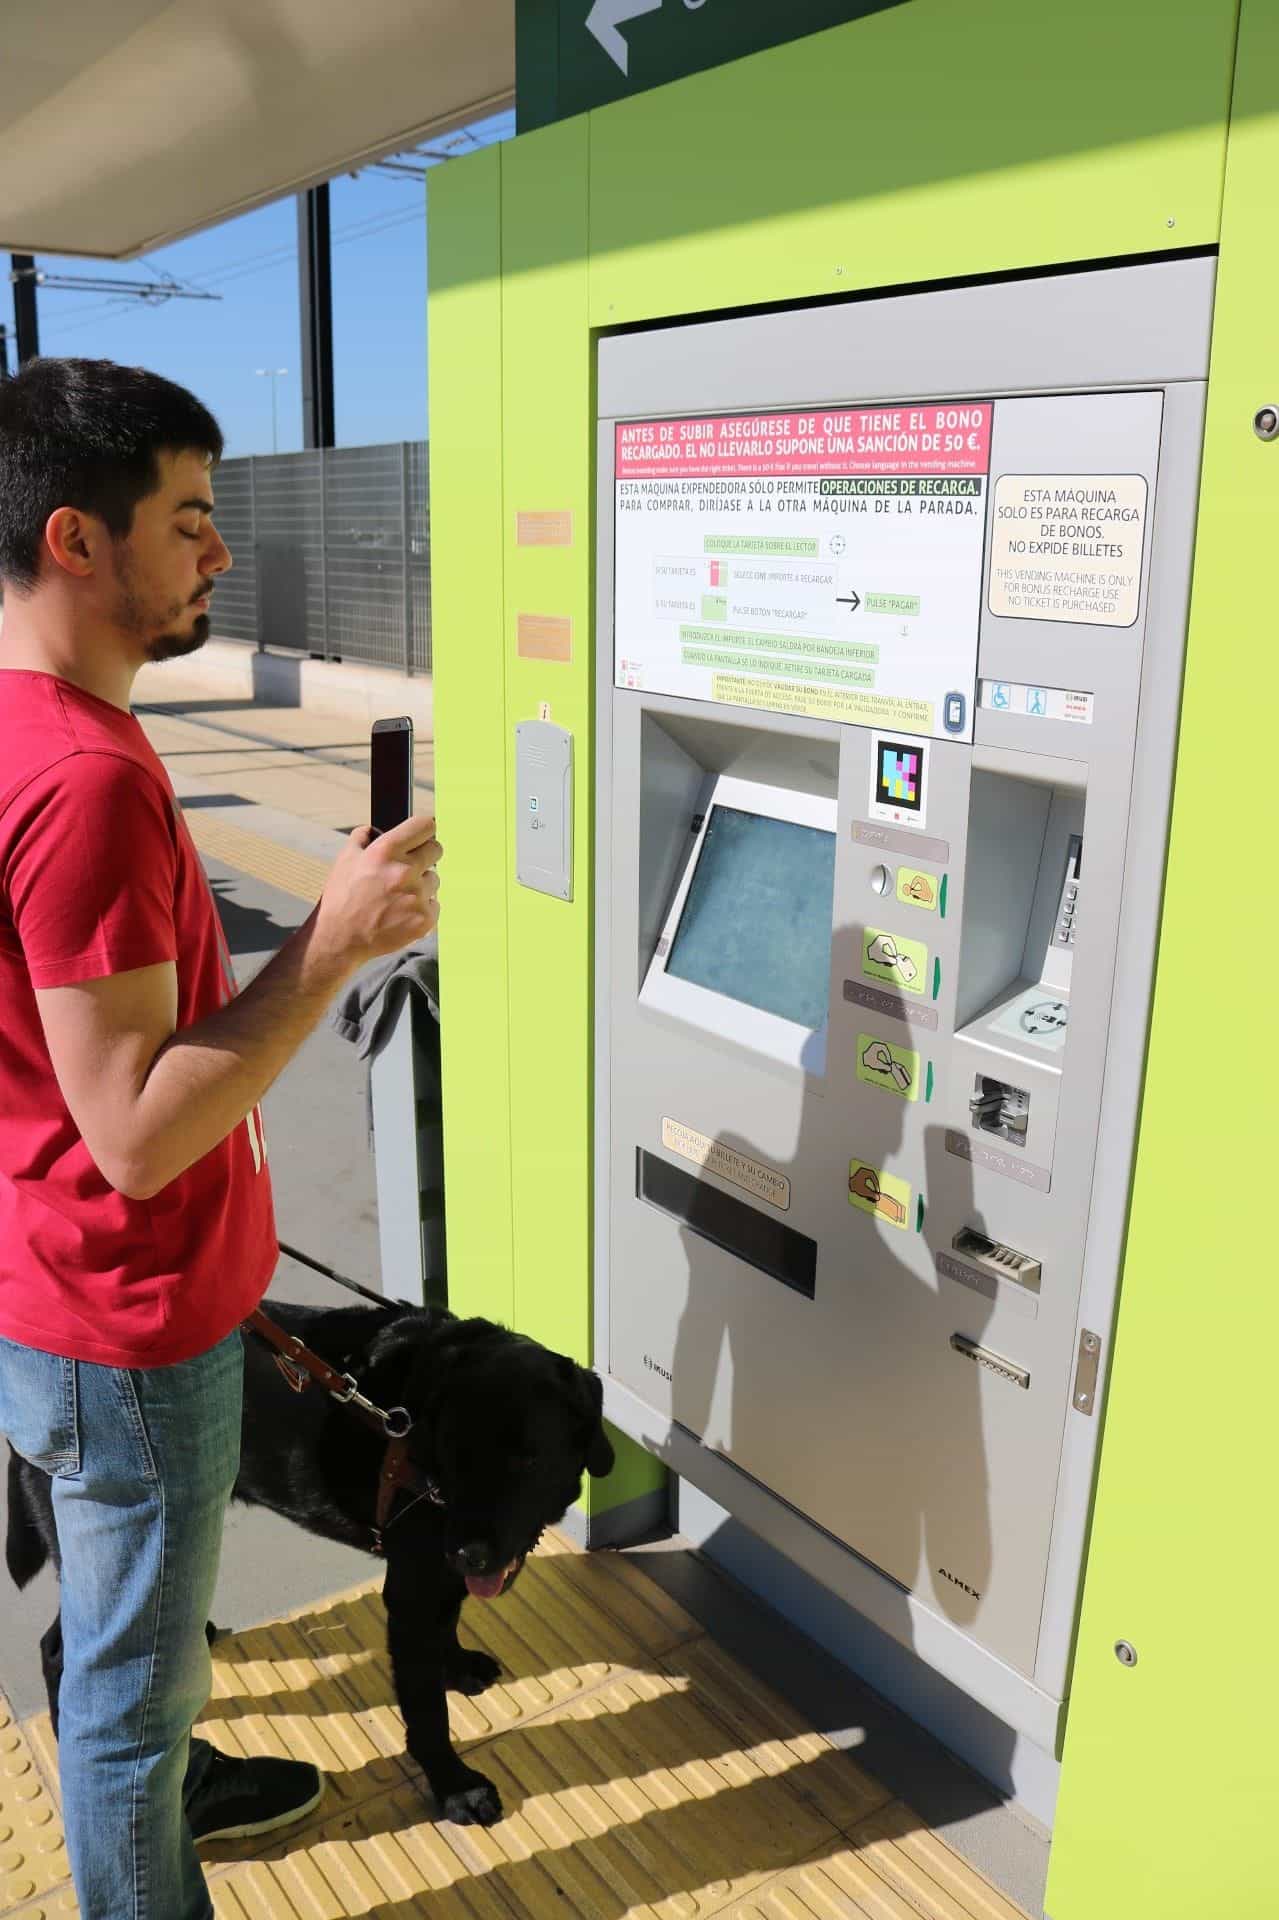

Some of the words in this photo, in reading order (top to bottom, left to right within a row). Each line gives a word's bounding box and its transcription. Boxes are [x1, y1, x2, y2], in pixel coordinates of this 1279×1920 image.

[621, 426, 655, 444] ANTES
[660, 425, 674, 442] DE
[680, 423, 714, 441] SUBIR
[720, 417, 791, 439] ASEGÚRESE
[798, 417, 815, 435] DE
[823, 415, 851, 436] QUE
[860, 412, 901, 433] TIENE
[910, 411, 927, 431] EL
[936, 409, 983, 430] BONO
[621, 444, 684, 461] RECARGADO.
[685, 442, 697, 459] EL
[700, 442, 715, 458] NO
[718, 439, 773, 458] LLEVARLO
[775, 437, 824, 456] SUPONE
[827, 436, 854, 454] UNA
[857, 431, 918, 453] SANCIÓN
[921, 433, 941, 451] DE
[943, 434, 963, 452] 50
[967, 432, 981, 450] €.
[620, 483, 639, 496] ESTA
[681, 480, 746, 496] EXPENDEDORA
[749, 479, 774, 495] SÓLO
[776, 479, 819, 494] PERMITE
[821, 480, 898, 495] OPERACIONES
[900, 481, 916, 495] DE
[918, 481, 979, 495] RECARGA.
[1023, 489, 1051, 502] ESTA
[1054, 487, 1117, 504] MÁQUINA
[620, 499, 642, 512] PARA
[646, 499, 694, 513] COMPRAR,
[699, 497, 742, 512] DIRÍJASE
[746, 499, 754, 512] A
[759, 499, 772, 512] LA
[777, 499, 807, 512] OTRA
[813, 496, 868, 516] MÁQUINA
[874, 500, 891, 513] DE
[897, 500, 912, 514] LA
[919, 500, 979, 516] PARADA.
[998, 506, 1028, 519] SOLO
[1030, 507, 1043, 520] ES
[1046, 507, 1078, 521] PARA
[1081, 508, 1140, 522] RECARGA
[1040, 524, 1056, 537] DE
[1059, 525, 1105, 539] BONOS.
[1008, 540, 1026, 553] NO
[1029, 541, 1069, 555] EXPIDE
[1072, 543, 1123, 558] BILLETES
[995, 568, 1013, 580] THIS
[1014, 569, 1053, 582] VENDING
[1054, 571, 1097, 585] MACHINE
[1098, 574, 1106, 585] IS
[1108, 575, 1134, 587] ONLY
[1003, 582, 1020, 593] FOR
[1021, 583, 1051, 595] BONUS
[1053, 585, 1100, 599] RECHARGE
[1102, 589, 1120, 600] USE
[1008, 596, 1021, 606] NO
[1024, 596, 1050, 608] TICKET
[1053, 598, 1061, 609] IS
[1062, 599, 1117, 613] PURCHASED
